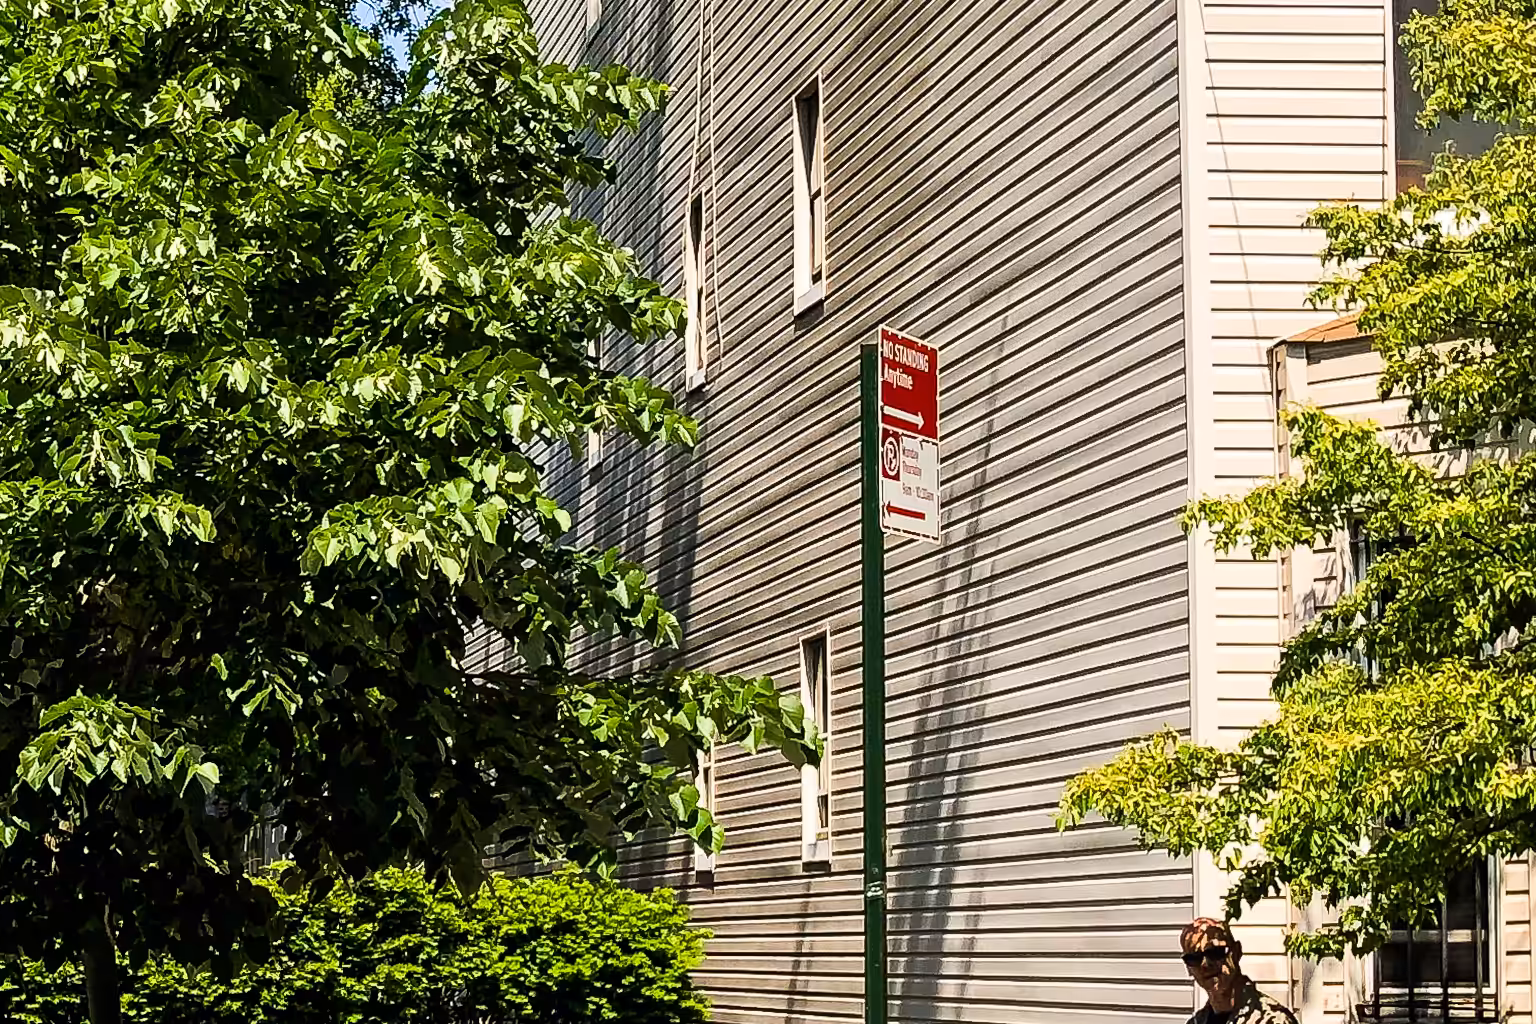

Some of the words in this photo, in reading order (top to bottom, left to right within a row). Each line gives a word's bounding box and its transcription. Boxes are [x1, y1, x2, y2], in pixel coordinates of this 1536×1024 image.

[883, 339, 894, 360] NO
[895, 344, 929, 373] STANDING
[884, 363, 913, 390] Anytime
